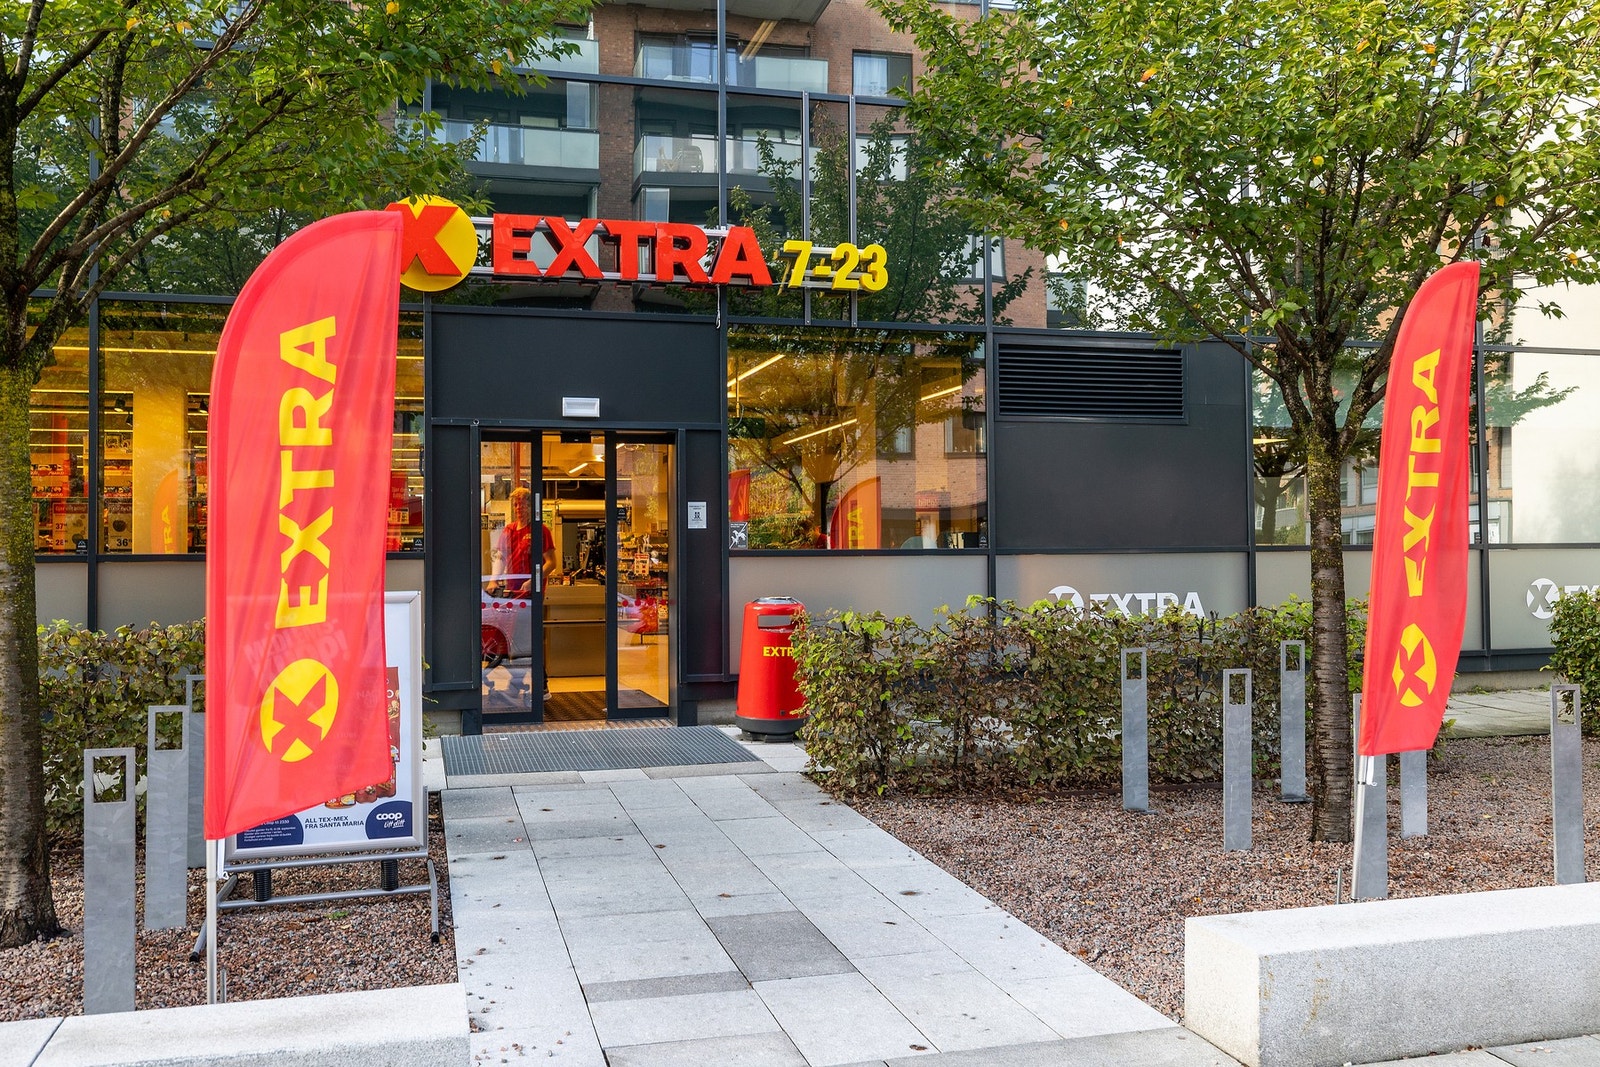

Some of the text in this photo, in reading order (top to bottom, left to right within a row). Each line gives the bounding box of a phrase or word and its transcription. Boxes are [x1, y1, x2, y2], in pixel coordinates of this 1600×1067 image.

[493, 213, 773, 287] EXTRA
[777, 239, 889, 293] 7-23
[275, 316, 337, 629] EXTRA
[1403, 348, 1441, 598] EXTRA
[1089, 591, 1207, 620] EXTRA
[763, 646, 796, 657] EXTR
[376, 812, 403, 821] coop
